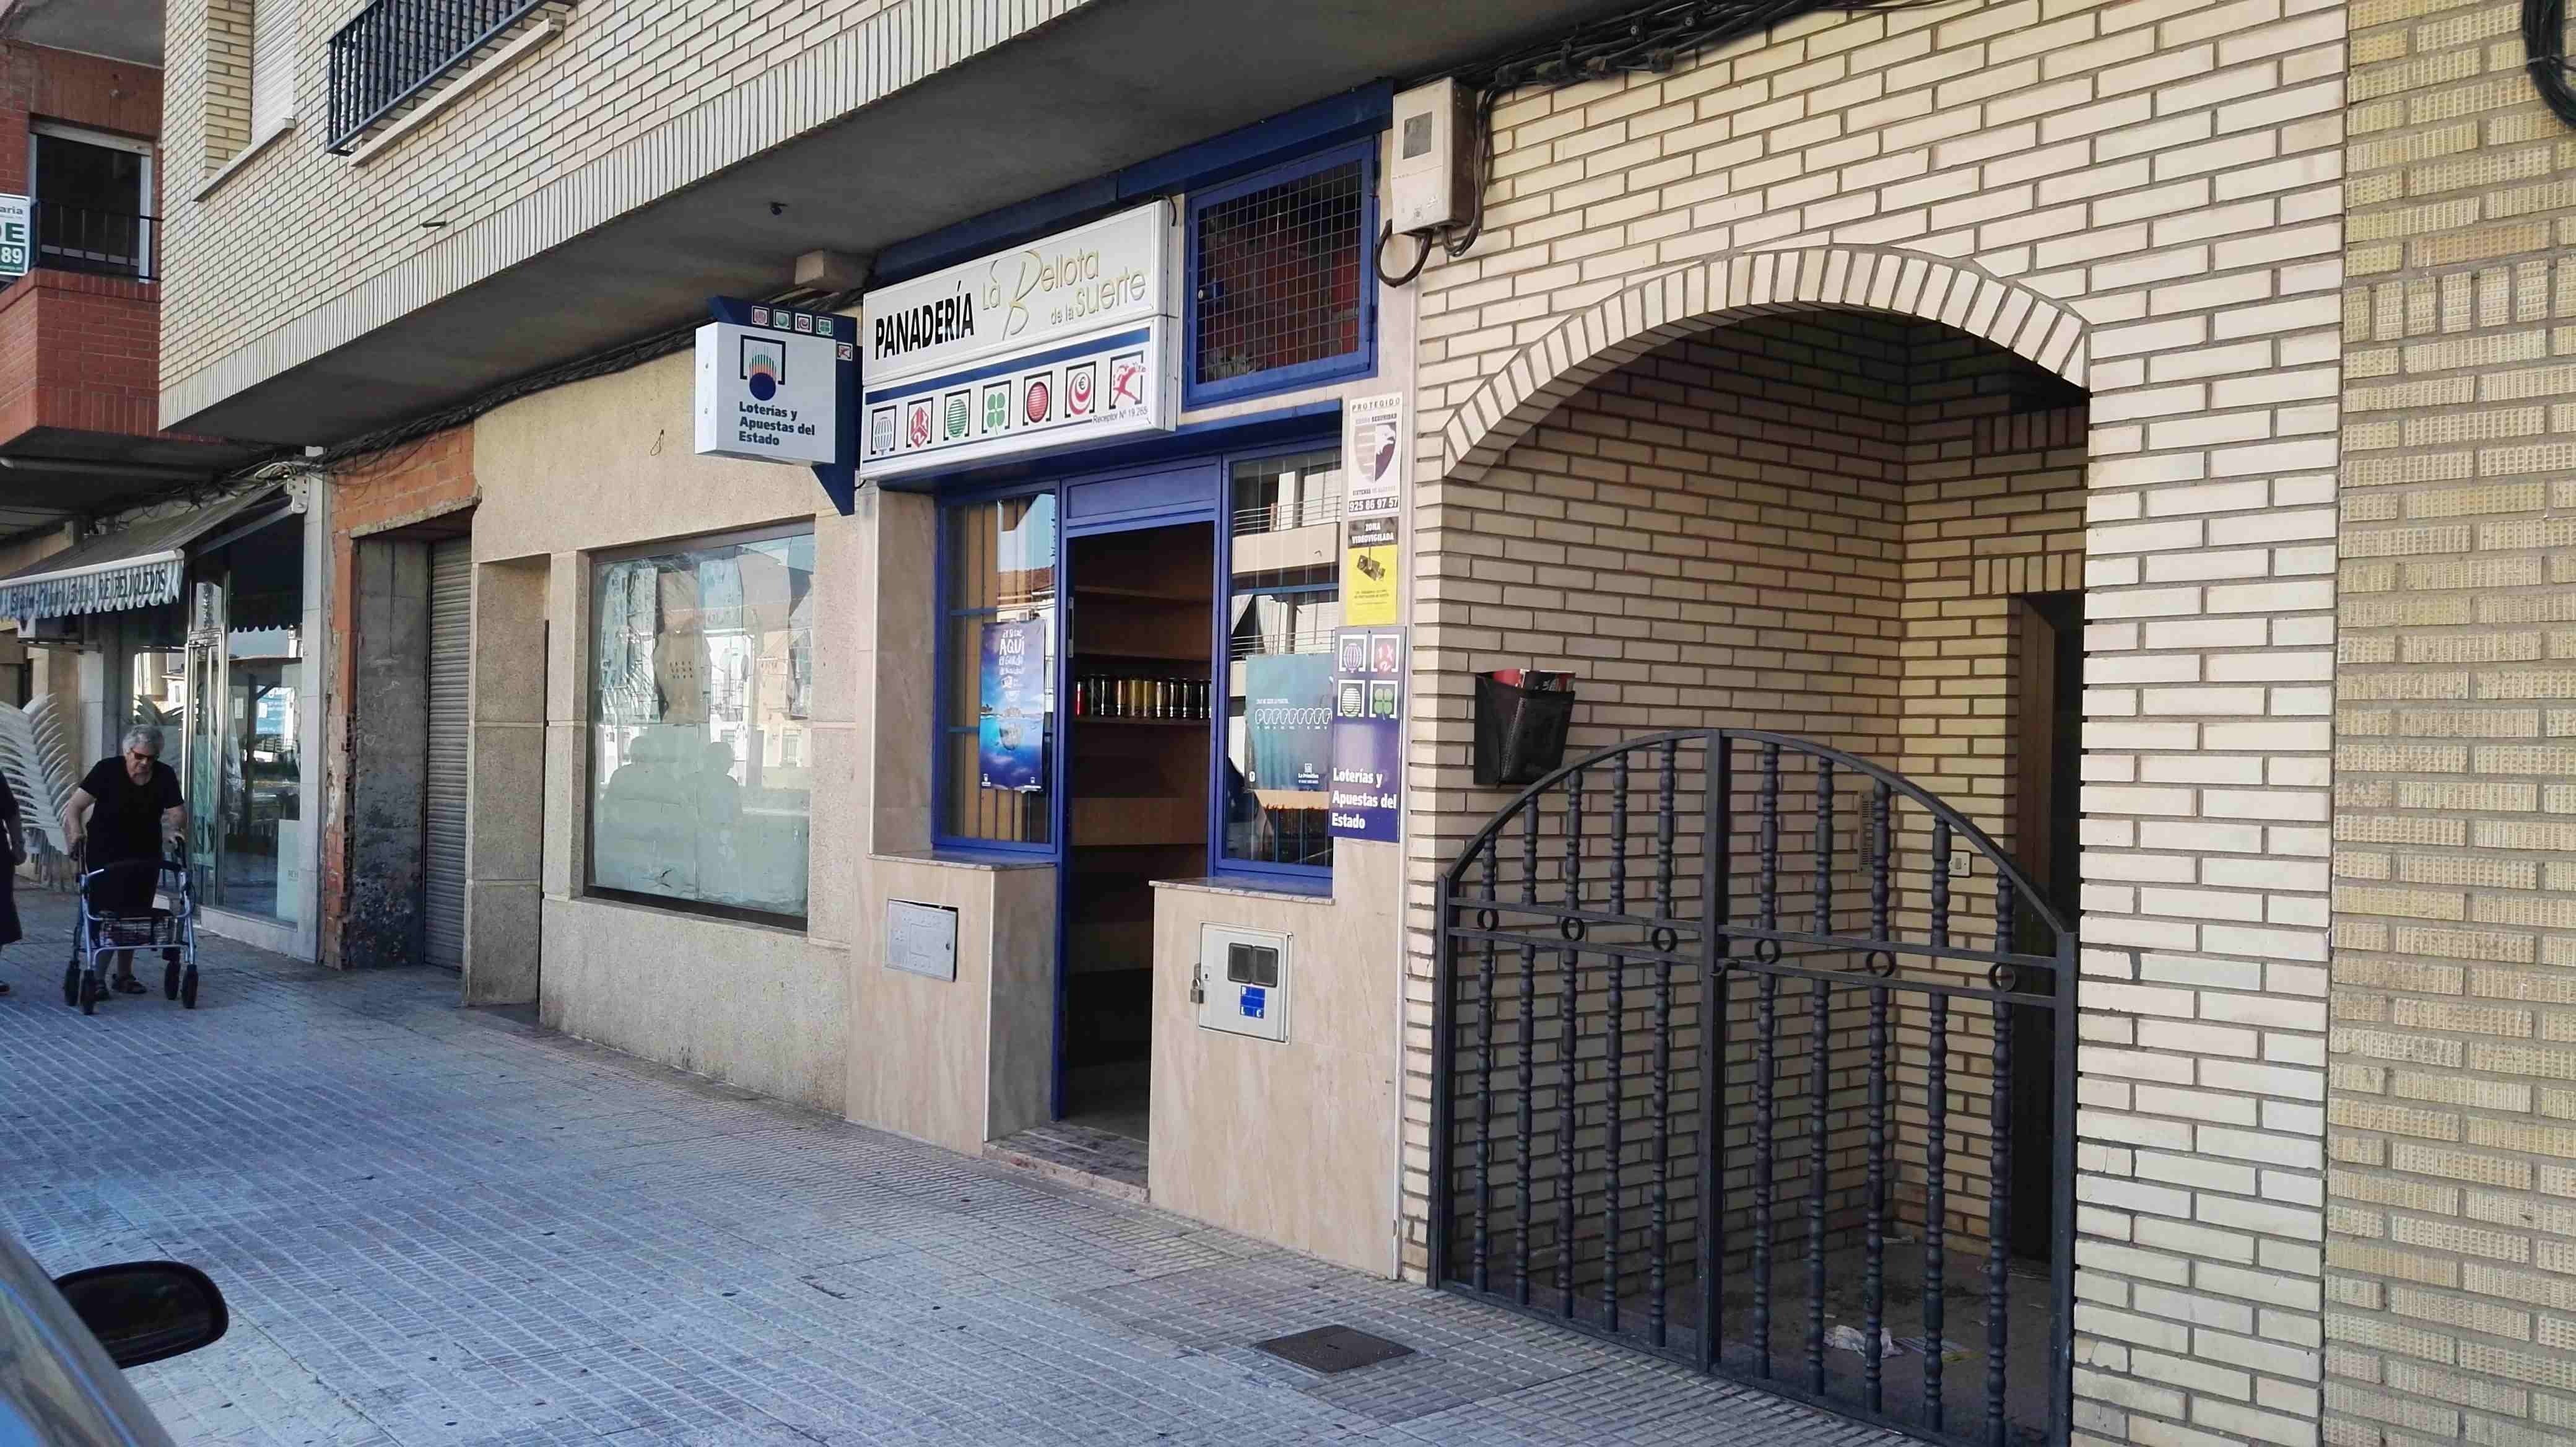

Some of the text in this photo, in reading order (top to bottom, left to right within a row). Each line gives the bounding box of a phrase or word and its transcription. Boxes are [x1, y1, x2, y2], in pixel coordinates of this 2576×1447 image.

[1, 247, 23, 264] 89
[983, 248, 1099, 341] La Bellota
[875, 281, 975, 360] PANADERÍA
[1051, 309, 1063, 325] de
[1065, 305, 1074, 321] la
[739, 401, 798, 421] Loterías y
[1352, 397, 1400, 412] PROTEGIDO
[739, 416, 816, 435] Apuestas del
[1092, 411, 1118, 424] Receptor
[738, 431, 780, 446] Estado
[1349, 496, 1398, 512] 925 86 97 57
[1365, 522, 1381, 531] ZONA
[1352, 533, 1394, 544] VIDEOVIGILADA
[999, 636, 1025, 655] AQUÍ
[1333, 767, 1383, 788] Loterías y
[1332, 790, 1397, 809] Apuestas del
[1331, 812, 1366, 829] Estado
[1242, 987, 1247, 995] B
[1256, 1009, 1262, 1017] C
